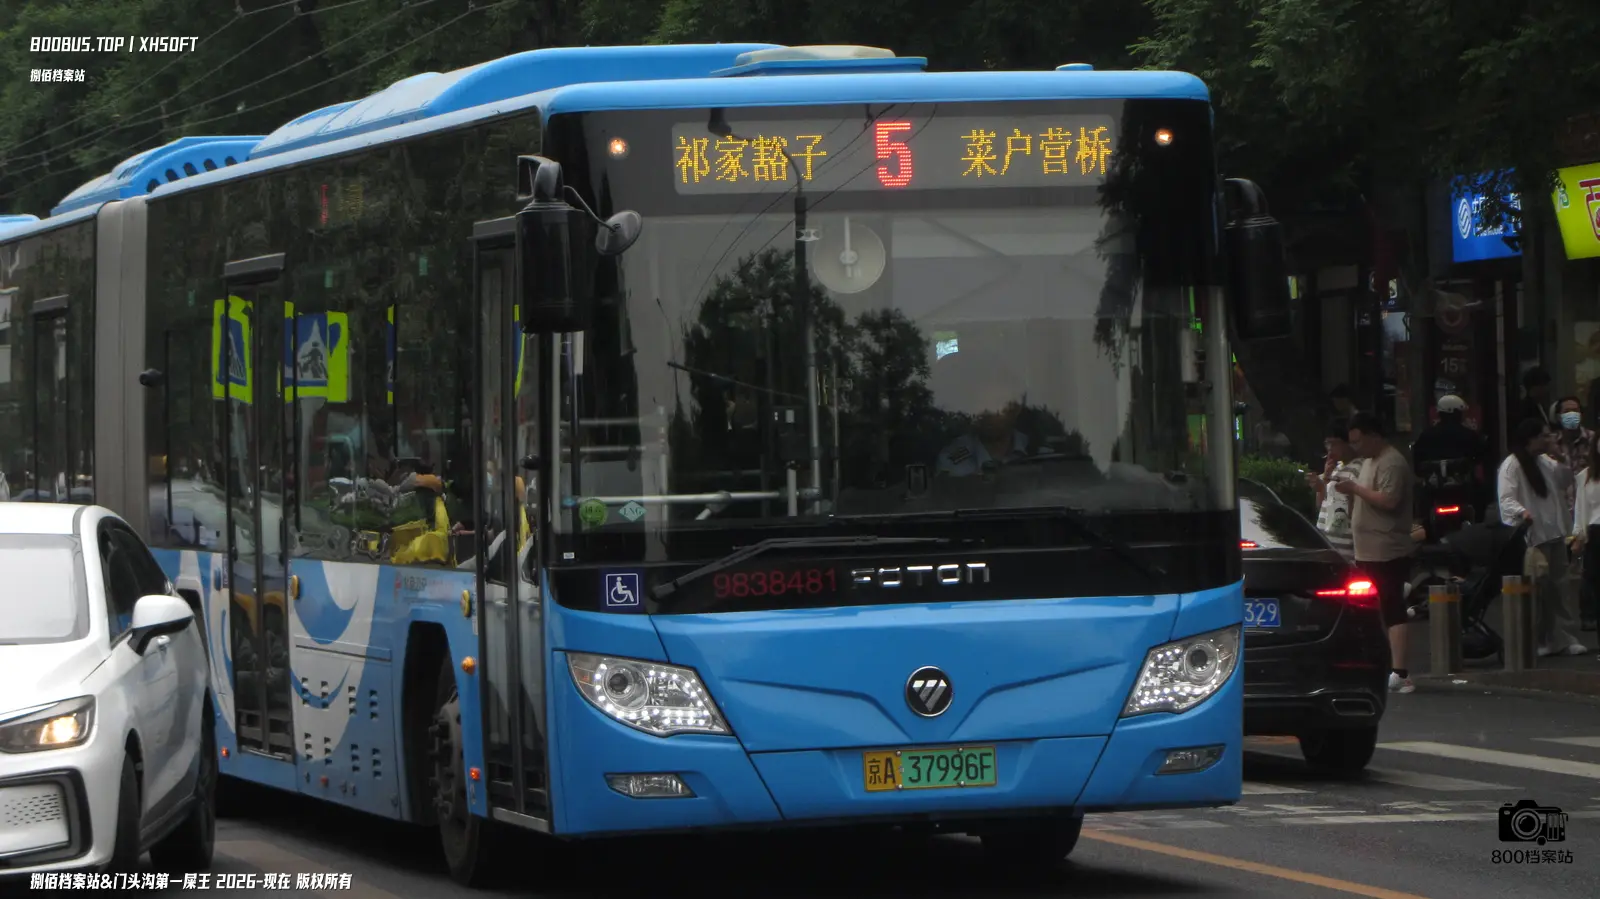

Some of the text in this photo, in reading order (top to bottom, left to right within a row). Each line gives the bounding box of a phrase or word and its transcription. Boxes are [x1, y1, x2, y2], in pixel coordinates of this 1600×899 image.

[675, 121, 1113, 187] 祁家豁子 5 菜户营桥
[713, 568, 837, 598] 9838481
[851, 561, 990, 590] FOTON
[867, 752, 992, 785] 京A 37996F
